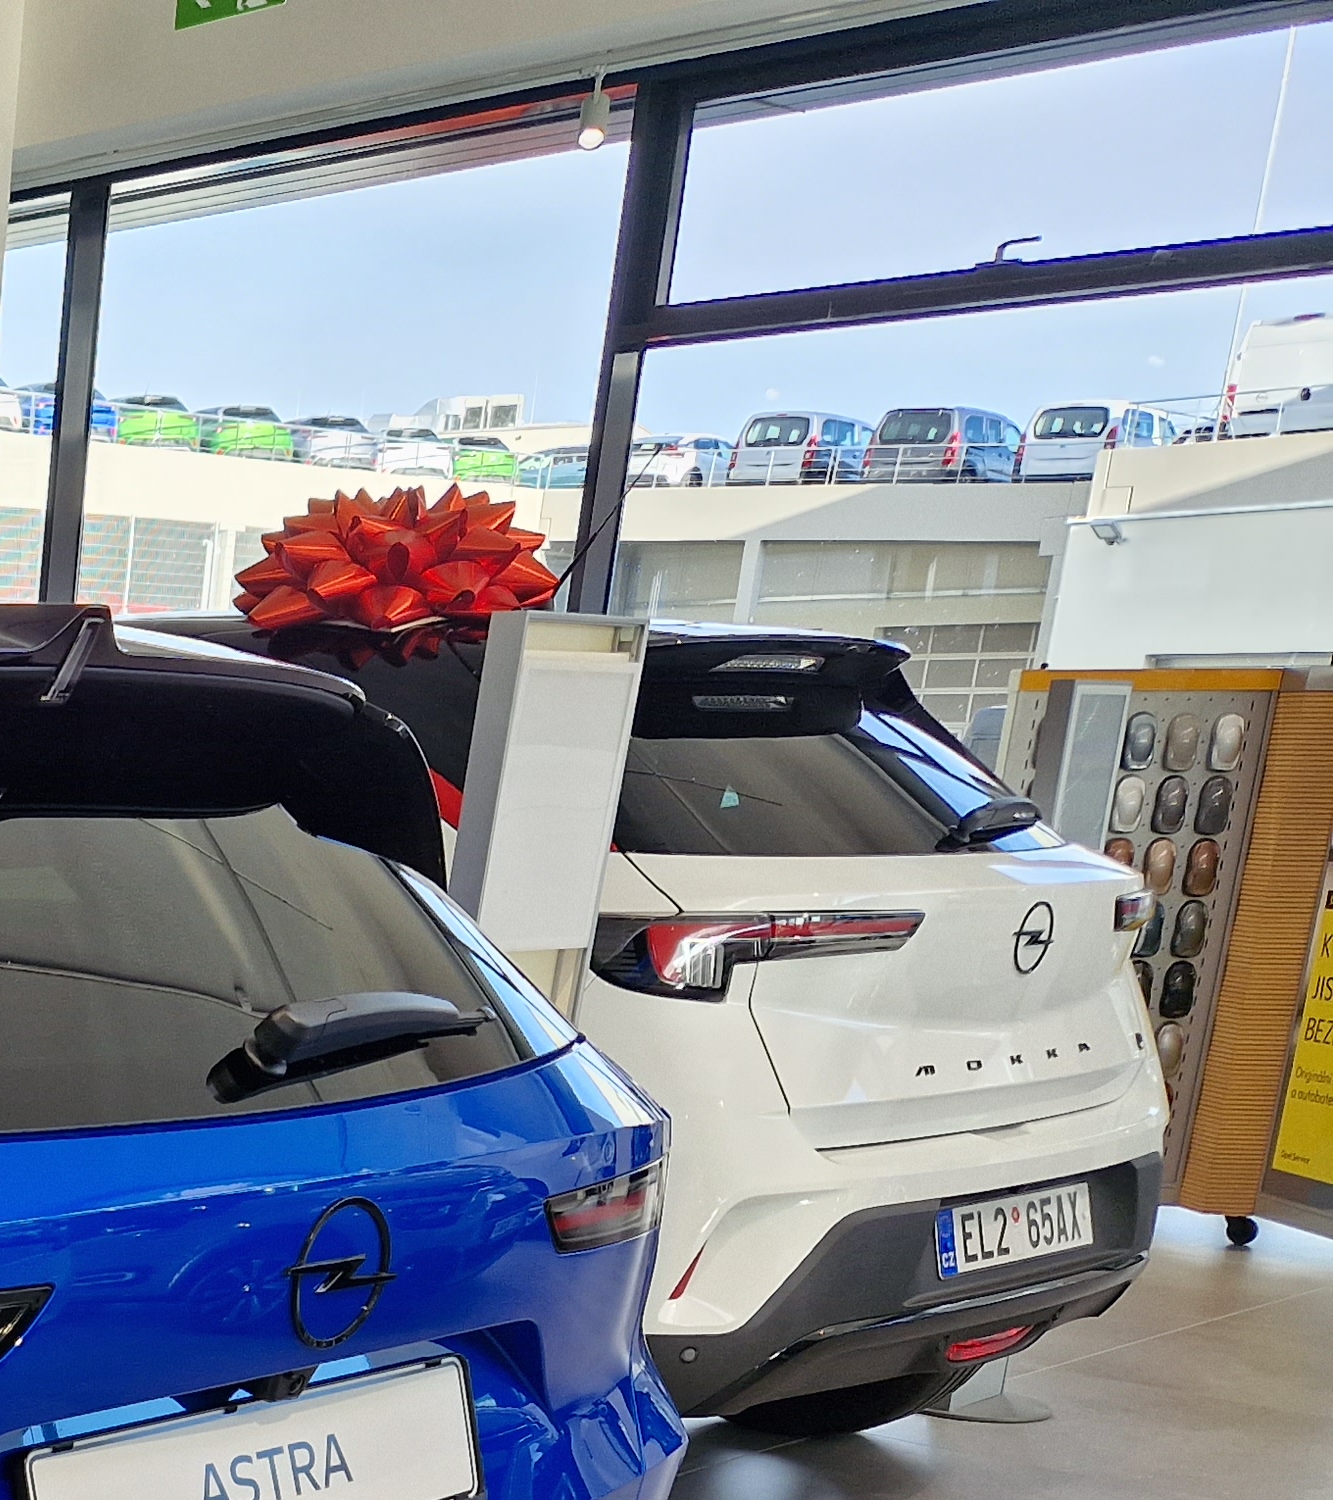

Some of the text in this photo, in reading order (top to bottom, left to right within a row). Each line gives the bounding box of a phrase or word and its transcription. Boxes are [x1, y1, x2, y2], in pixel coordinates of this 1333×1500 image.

[915, 1042, 1091, 1077] MOKKA
[960, 1191, 1082, 1264] EL2 65AX
[941, 1251, 956, 1269] CZ
